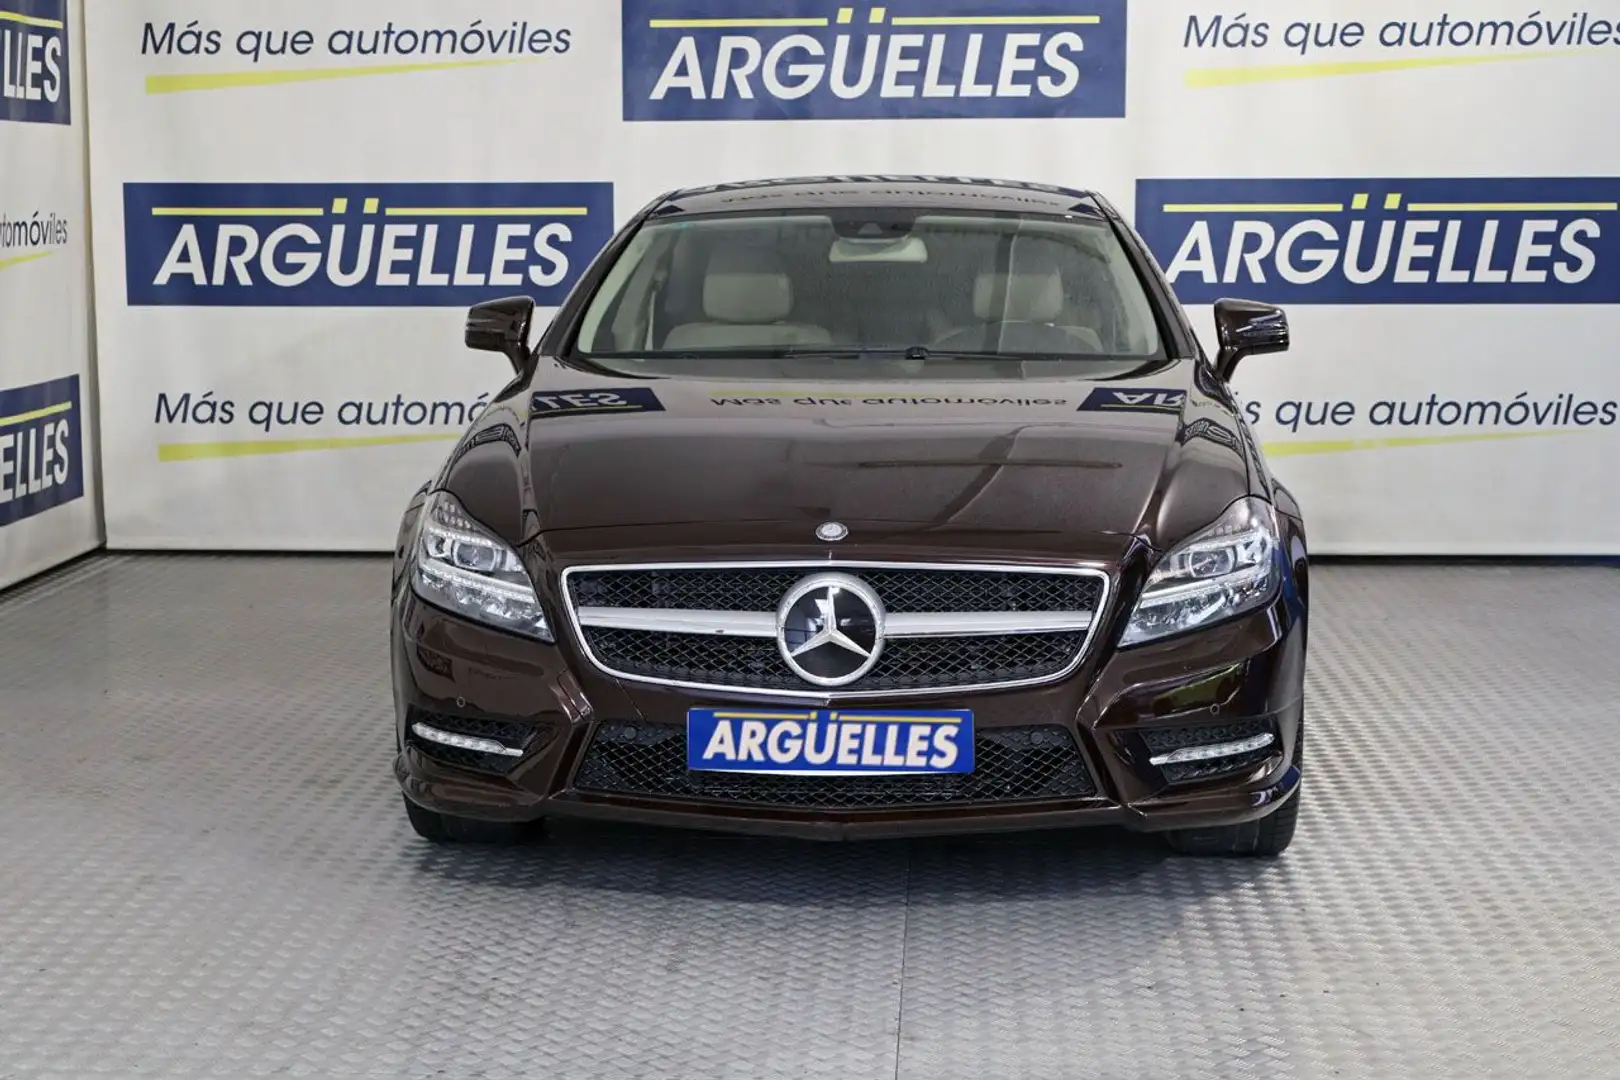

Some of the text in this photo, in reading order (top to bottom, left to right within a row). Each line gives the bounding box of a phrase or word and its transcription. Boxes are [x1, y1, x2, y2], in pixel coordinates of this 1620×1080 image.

[141, 19, 571, 63] Más que automóviles
[649, 7, 1084, 100] ARGÜELLES
[1184, 13, 1268, 48] Más
[1284, 22, 1364, 55] que
[0, 210, 67, 249] tomóviles
[153, 197, 573, 288] ARGÜELLES
[1164, 193, 1601, 286] ARGÜELLES
[154, 390, 235, 425] Más
[248, 400, 325, 433] que
[1275, 401, 1356, 433] que
[1368, 391, 1618, 426] automóviles
[702, 711, 959, 769] ARGÜELLES
